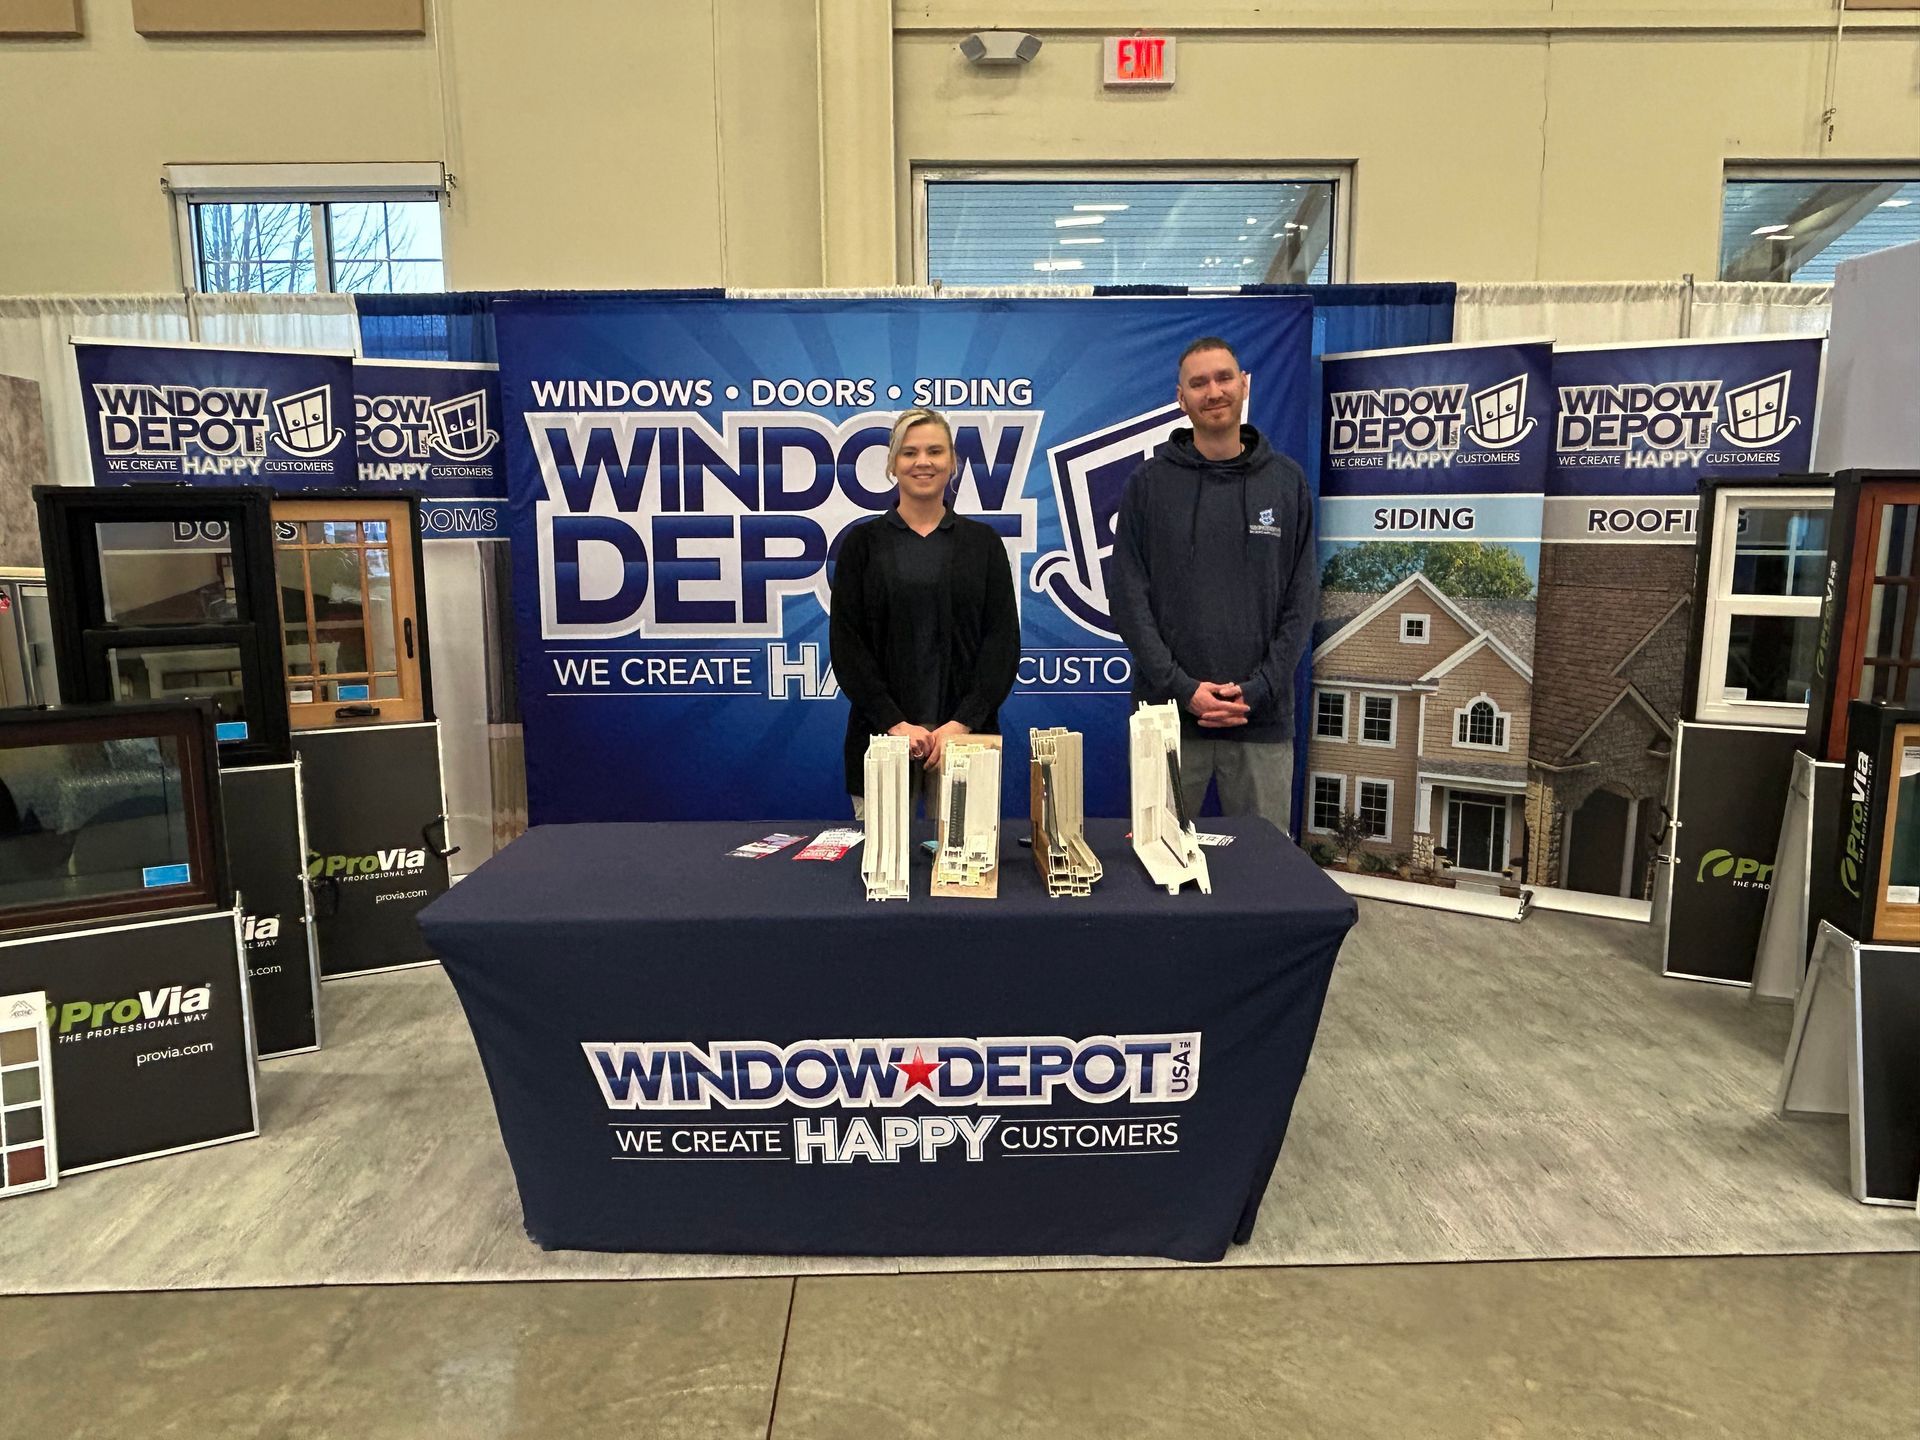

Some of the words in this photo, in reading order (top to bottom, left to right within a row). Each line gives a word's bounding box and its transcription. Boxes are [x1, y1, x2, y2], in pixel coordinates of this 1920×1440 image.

[1116, 38, 1167, 81] EXIT
[99, 387, 260, 418] WINDOW
[530, 379, 714, 408] WINDOWS
[751, 377, 877, 407] DOORS
[912, 376, 1034, 406] SIDING
[1334, 387, 1464, 420] WINDOW
[1563, 384, 1710, 415] WINDOW
[104, 414, 264, 453] DEPOT
[1332, 413, 1461, 451] DEPOT
[1561, 411, 1713, 448] DEPOT
[108, 459, 128, 471] WE
[130, 459, 178, 471] CREATE
[182, 457, 267, 476] HAPPY
[264, 460, 335, 472] CUSTOMERS
[357, 462, 431, 481] HAPPY
[431, 466, 494, 477] CUSTOMERS
[1331, 459, 1346, 468] WE
[1347, 457, 1384, 467] CREATE
[1386, 451, 1457, 471] HAPPY
[1456, 452, 1521, 465] CUSTOMERS
[1558, 456, 1577, 466] WE
[1578, 455, 1621, 465] CREATE
[1624, 450, 1707, 469] HAPPY
[1705, 452, 1781, 464] CUSTOMERS
[1373, 507, 1476, 532] SIDING
[1587, 508, 1699, 534] ROOFI
[553, 657, 610, 686] WE
[620, 656, 752, 686] CREATE
[1846, 751, 1869, 861] ProVia
[325, 848, 426, 877] ProVia
[375, 888, 428, 904] provia.com
[58, 984, 211, 1034] ProVia
[59, 1032, 82, 1044] THE
[87, 1020, 180, 1039] PROFESSIONAL
[184, 1012, 208, 1023] WAY
[136, 1041, 214, 1067] provia.com
[597, 1044, 905, 1103] WINDOW
[930, 1040, 1173, 1100] DEPOT
[1171, 1050, 1191, 1093] USA
[616, 1129, 663, 1154] WE
[671, 1128, 783, 1154] CREATE
[793, 1115, 1002, 1165] HAPPY
[1000, 1121, 1180, 1151] CUSTOMERS
